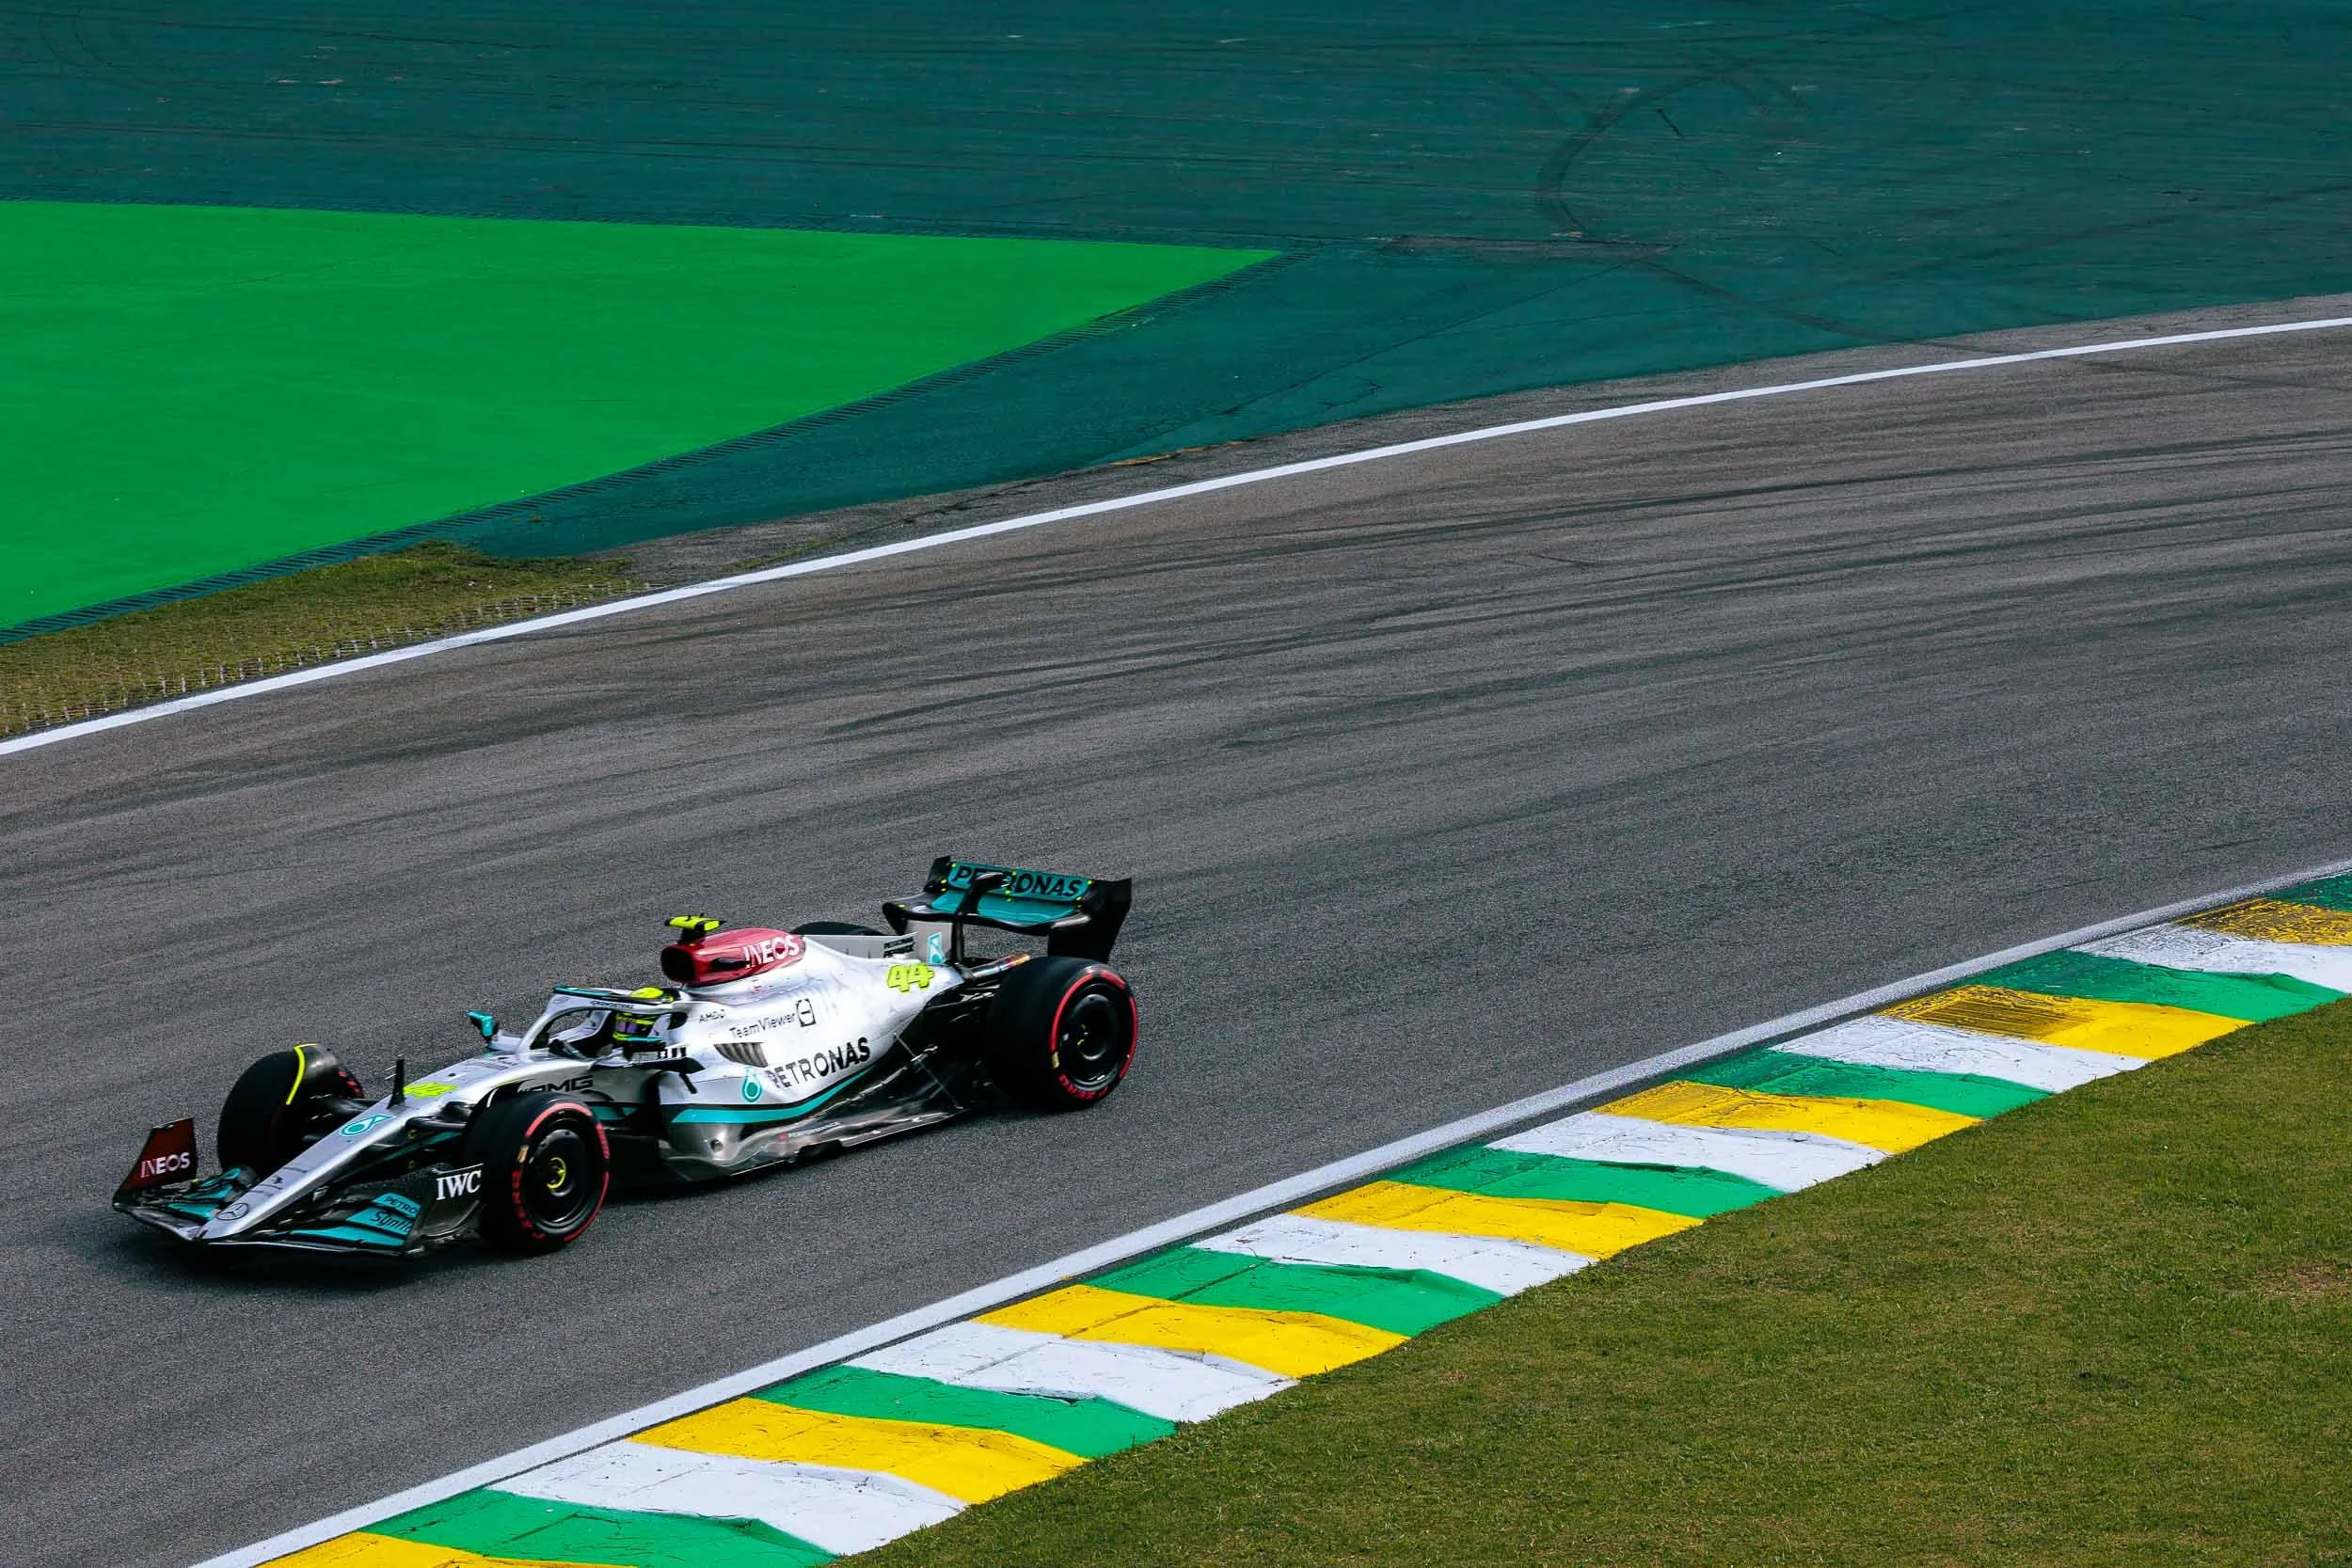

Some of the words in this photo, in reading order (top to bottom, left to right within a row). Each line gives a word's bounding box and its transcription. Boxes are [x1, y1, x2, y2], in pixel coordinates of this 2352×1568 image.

[743, 934, 801, 970] INEOS
[887, 962, 935, 992] 44
[729, 1012, 796, 1040] TeamViewer
[764, 1036, 872, 1090] PETRONAS
[140, 1151, 192, 1180] INEOS
[436, 1169, 483, 1201] IWC
